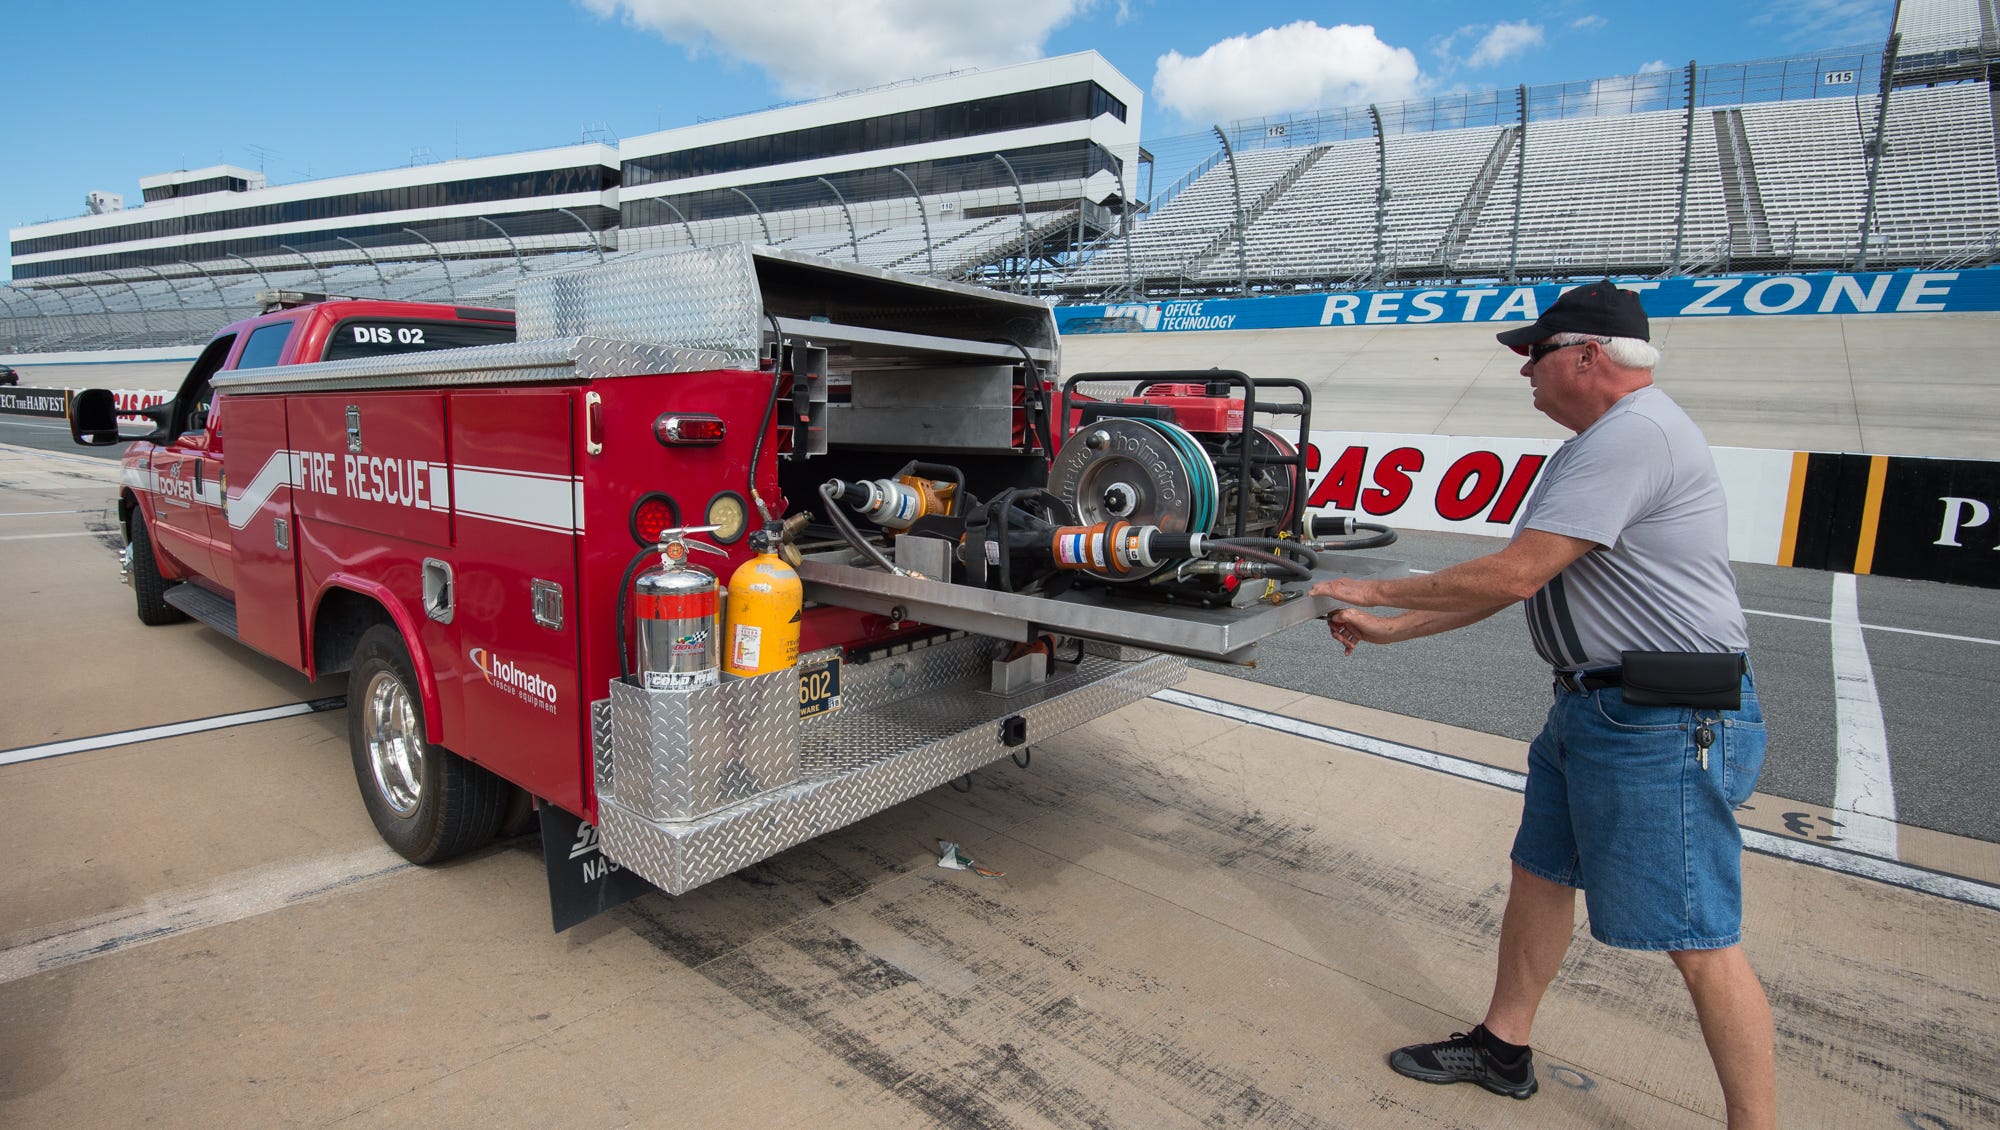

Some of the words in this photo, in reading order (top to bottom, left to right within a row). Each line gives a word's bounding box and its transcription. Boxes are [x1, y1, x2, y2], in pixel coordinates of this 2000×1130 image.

[1826, 72, 1852, 83] 115
[1165, 302, 1204, 317] OFFICE
[1319, 281, 1661, 326] RESTA
[1679, 271, 1960, 315] ZONE
[353, 326, 393, 344] DIS
[397, 327, 425, 344] 02
[1162, 314, 1237, 331] TECHNOLOGY
[16, 399, 27, 409] THE
[26, 395, 65, 412] HARVEST
[160, 476, 193, 501] DOVER
[299, 450, 338, 496] FIRE
[344, 454, 430, 510] RESCUE
[1434, 450, 1548, 524] OI
[1932, 496, 2000, 550] P
[493, 653, 557, 704] holmatro
[799, 670, 832, 704] 602
[493, 679, 516, 696] rescue
[519, 689, 558, 716] equipment
[800, 704, 820, 715] WARE
